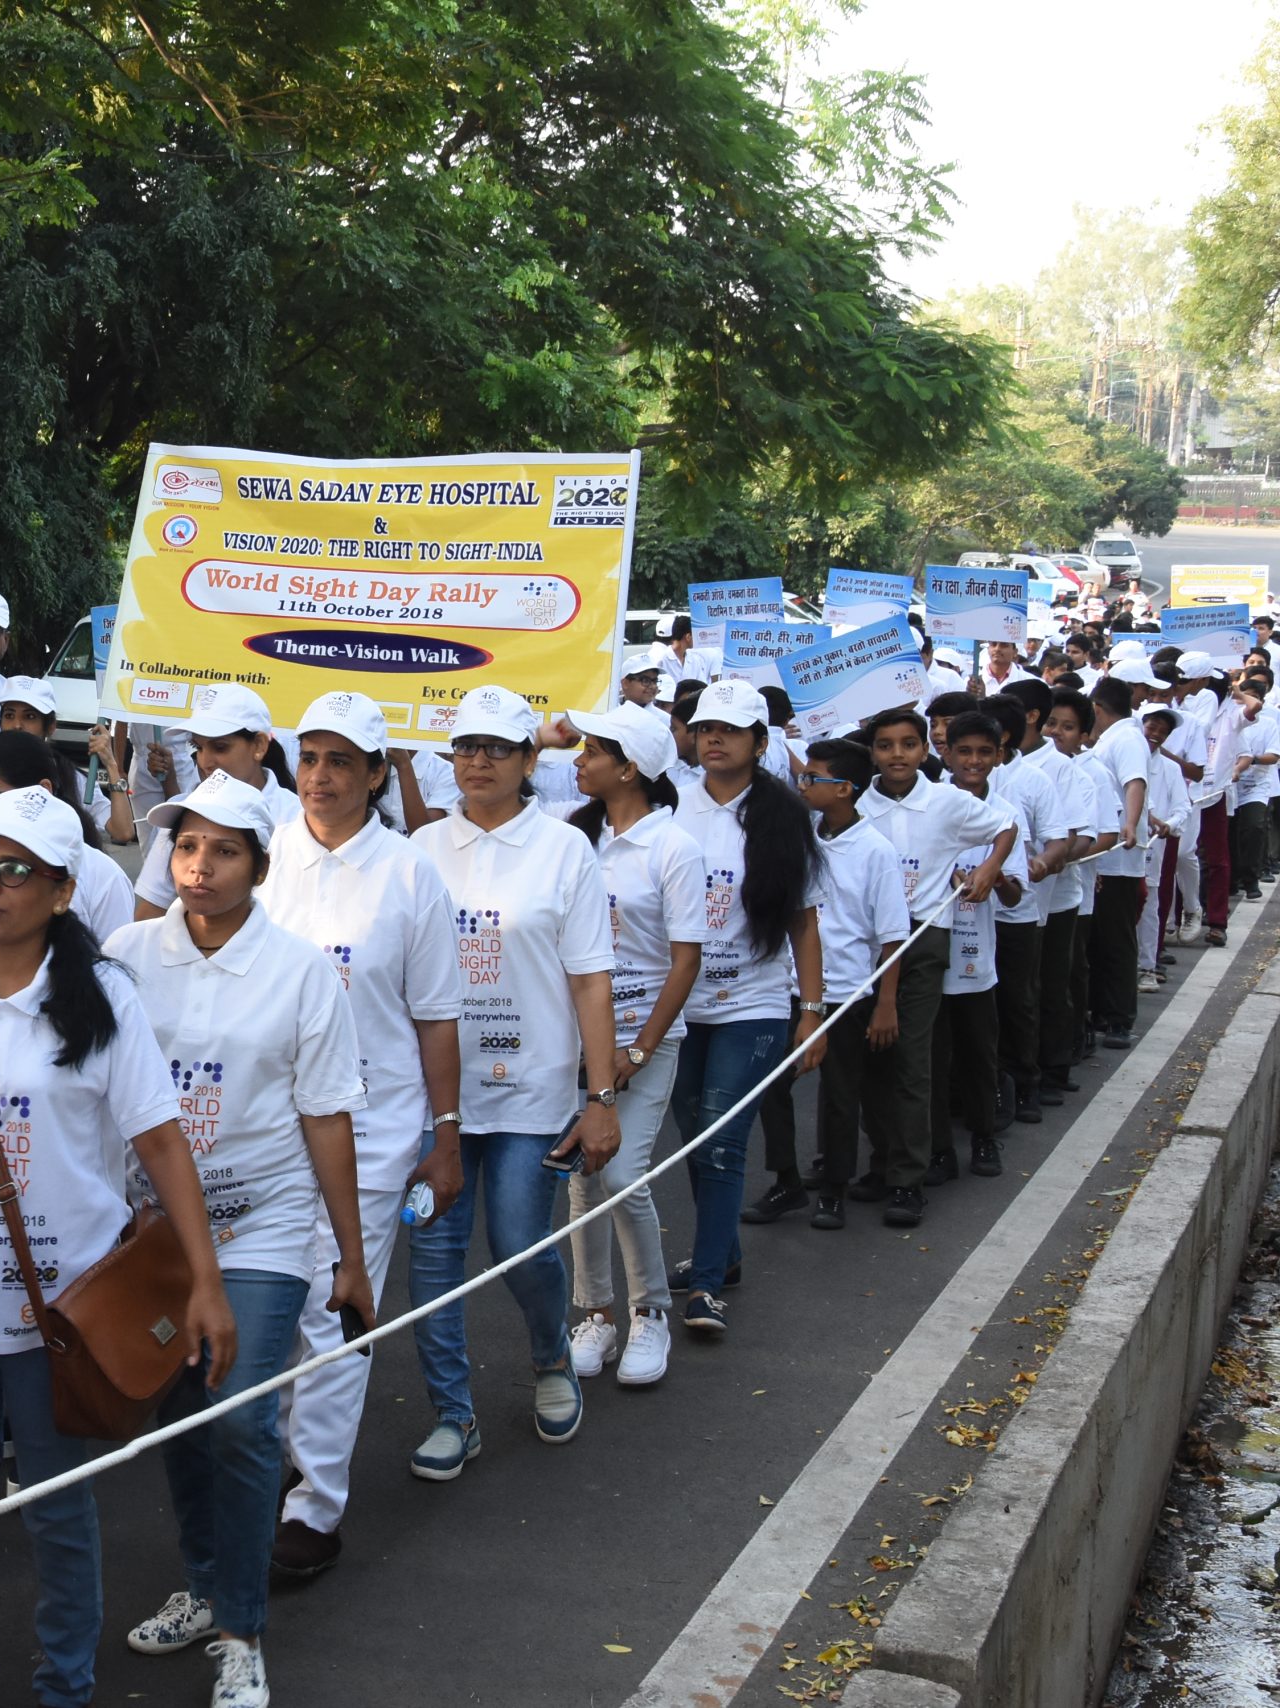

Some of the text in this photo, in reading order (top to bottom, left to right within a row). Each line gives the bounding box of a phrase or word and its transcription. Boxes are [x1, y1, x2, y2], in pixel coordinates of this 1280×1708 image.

[237, 477, 540, 505] SEWA SADAN EYE HOSPITAL
[557, 487, 628, 507] 2020
[374, 517, 387, 534] &
[224, 533, 543, 561] VISION 2020: THE RIGHT TO SIGHT-INDIA
[206, 568, 498, 608] World Sight Day Rally
[932, 575, 943, 593] नेत्र
[965, 578, 986, 596] जीवन
[988, 580, 998, 597] की
[1001, 584, 1023, 603] सुरक्षा
[278, 600, 443, 619] 11th October 2018
[516, 599, 557, 608] WORLD
[524, 608, 556, 617] SIGHT
[534, 618, 556, 626] DAY
[796, 631, 813, 644] मोती
[867, 628, 898, 647] सावधानी
[275, 639, 460, 664] Theme-Vision Walk
[738, 645, 756, 656] सबसे
[759, 646, 783, 658] कीमती
[120, 659, 271, 685] In Collaboration with:
[814, 669, 822, 681] तो
[824, 663, 845, 677] जीवन
[139, 687, 169, 699] cbm
[422, 686, 467, 701] Eye Ca
[715, 884, 733, 893] 2018
[705, 892, 731, 905] RLD
[958, 902, 976, 912] DAY
[707, 918, 727, 930] AY
[480, 928, 501, 938] 2018
[459, 939, 501, 953] ORLD
[714, 940, 734, 948] 2018
[702, 951, 739, 960] erywhere
[469, 971, 501, 984] DAY
[705, 970, 738, 979] 2020
[489, 998, 512, 1007] 2018
[464, 1012, 521, 1022] Everywhere
[480, 1036, 521, 1049] 2020
[480, 1080, 517, 1088] Sightsavers
[194, 1085, 222, 1097] 2018
[180, 1097, 220, 1115] RLD
[6, 1121, 31, 1133] 2018
[177, 1118, 219, 1137] GHT
[191, 1138, 218, 1155] AY
[203, 1167, 233, 1180] 2018
[23, 1215, 46, 1227] 018
